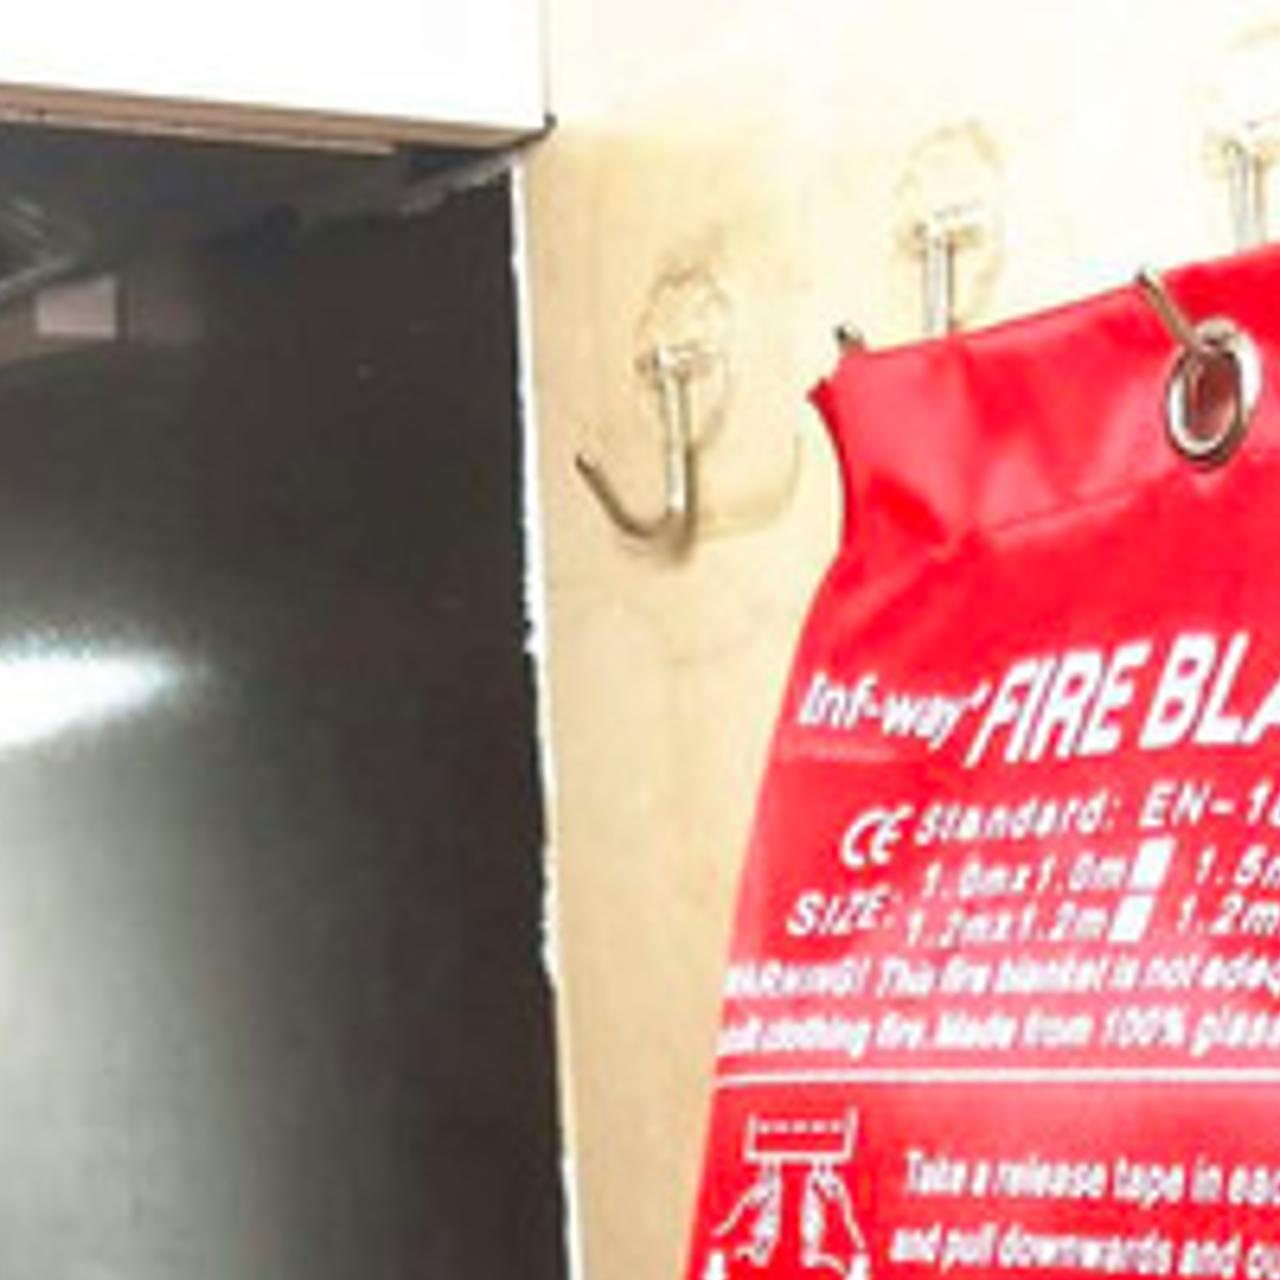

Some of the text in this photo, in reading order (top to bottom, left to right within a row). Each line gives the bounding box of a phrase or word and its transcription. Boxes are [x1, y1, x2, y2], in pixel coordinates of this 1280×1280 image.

[963, 640, 1152, 769] FIRE
[938, 952, 990, 995] fire
[994, 955, 1109, 994] blanket
[1142, 953, 1198, 989] not
[1101, 1004, 1187, 1050] 100%
[993, 1152, 1107, 1198] release
[1113, 1154, 1184, 1211] tape
[1191, 1155, 1222, 1204] in
[888, 1221, 942, 1265] and
[939, 1222, 998, 1274] pull
[998, 1221, 1172, 1277] downwards
[1177, 1231, 1242, 1280] and
